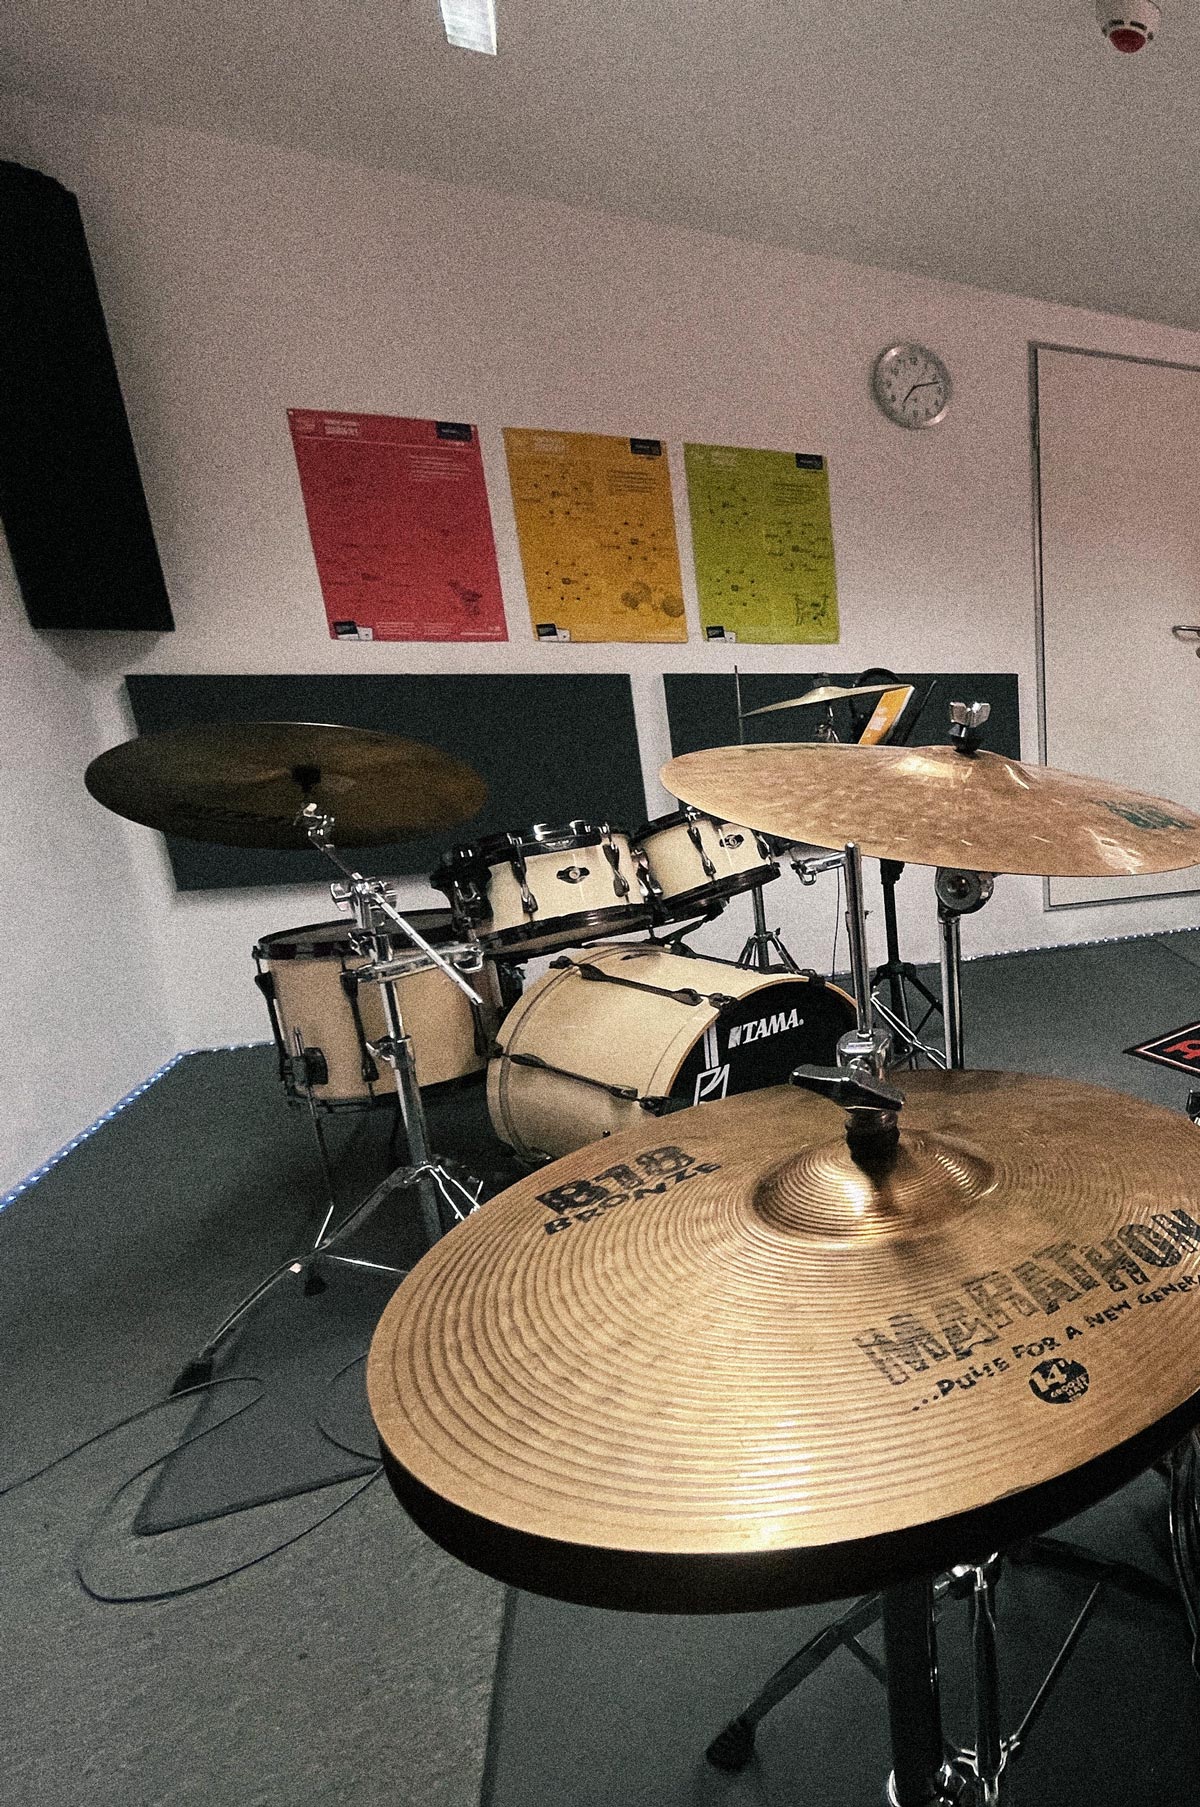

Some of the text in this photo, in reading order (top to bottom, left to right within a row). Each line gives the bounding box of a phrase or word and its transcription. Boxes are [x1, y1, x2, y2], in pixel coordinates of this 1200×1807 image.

[742, 1008, 800, 1045] TAMA
[535, 1146, 695, 1214] B18
[544, 1163, 721, 1235] BRONZE
[1012, 1337, 1062, 1359] FOR
[1065, 1325, 1083, 1340] A
[1084, 1300, 1132, 1328] NEW
